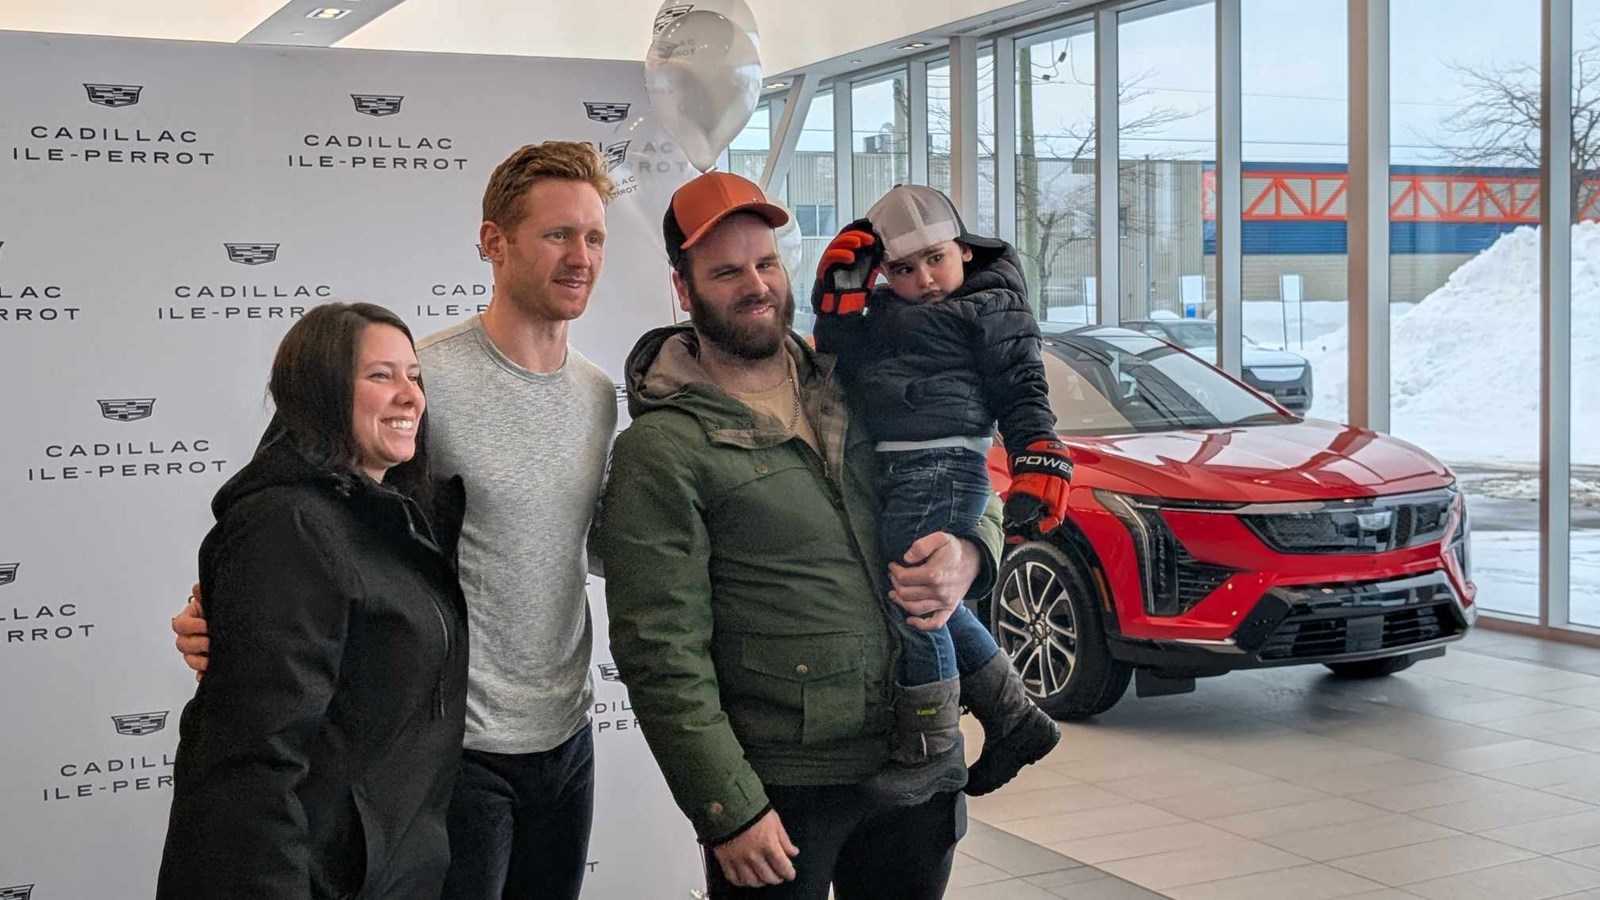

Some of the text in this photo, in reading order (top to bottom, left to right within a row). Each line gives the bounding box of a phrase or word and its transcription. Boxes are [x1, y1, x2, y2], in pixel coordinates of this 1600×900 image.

[31, 126, 197, 143] CADILLAC
[303, 134, 453, 150] CADILLAC
[13, 147, 215, 165] ILE-PERROT
[288, 154, 468, 170] ILE-PERROT
[174, 285, 331, 298] CADILLAC
[45, 439, 210, 458] CADILLAC
[28, 460, 227, 481] ILE-PERROT
